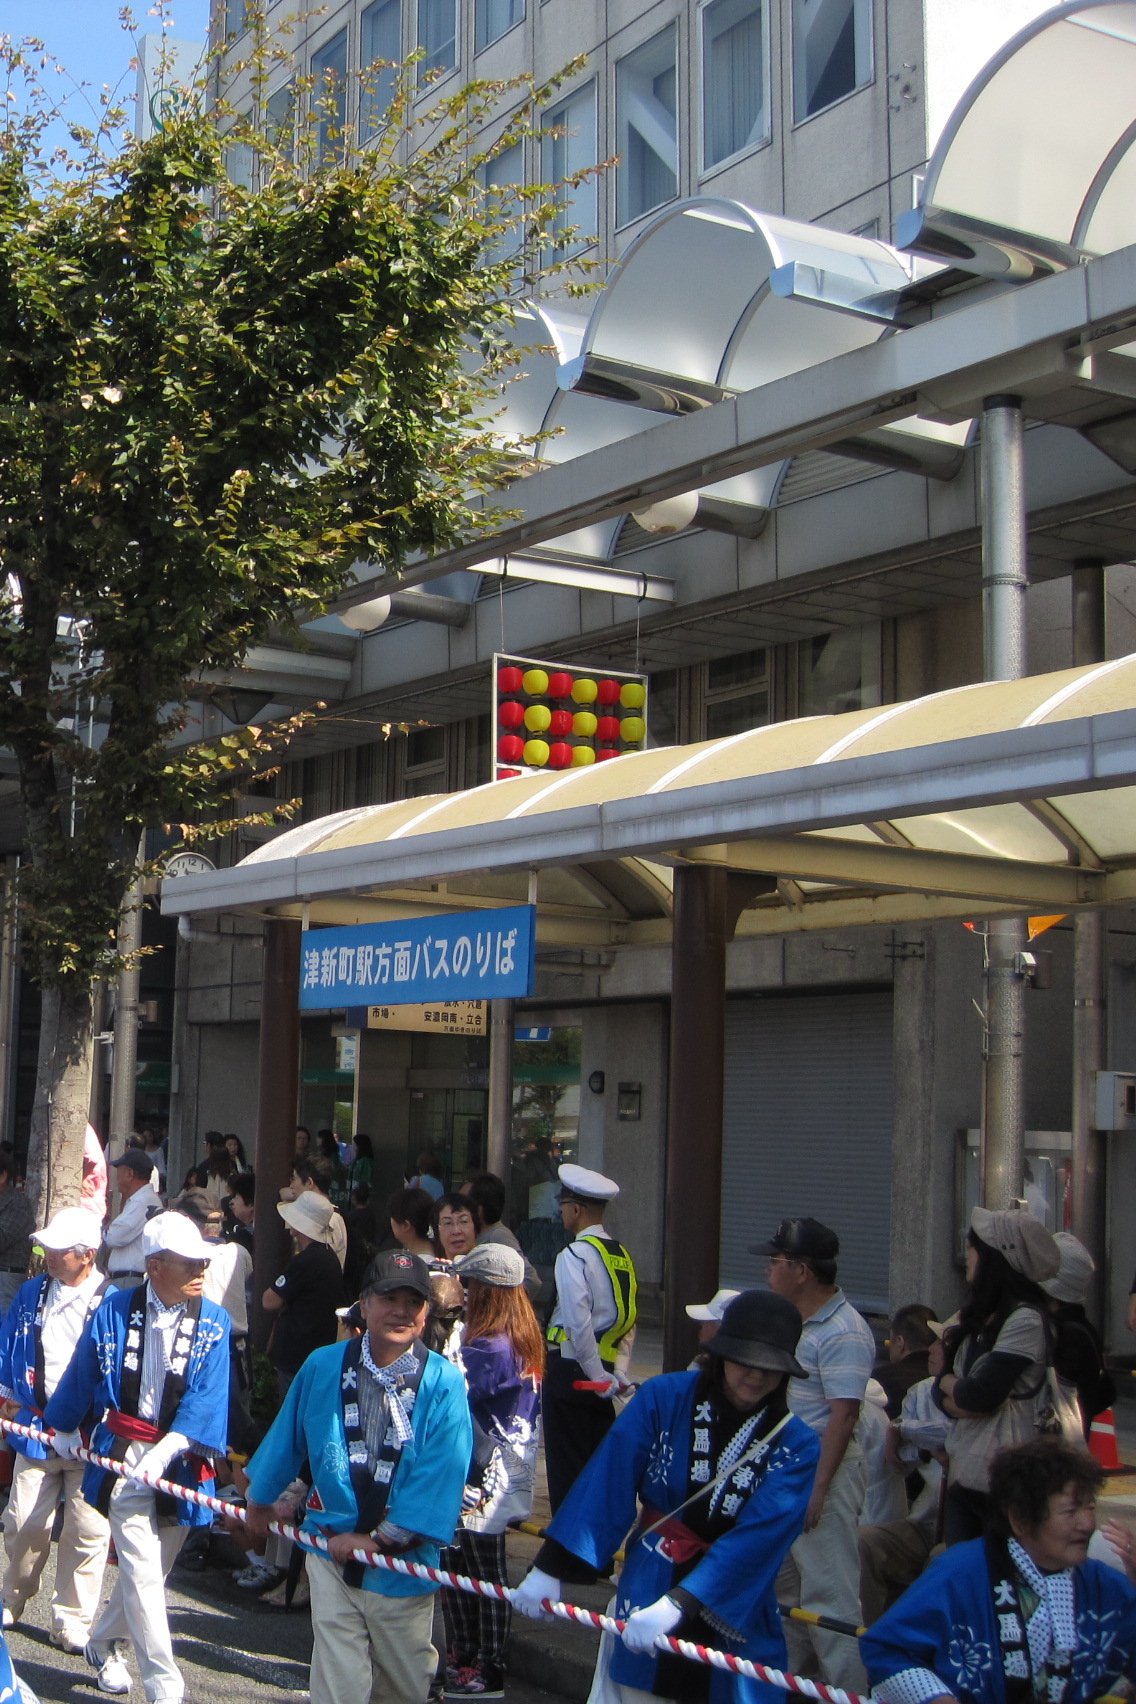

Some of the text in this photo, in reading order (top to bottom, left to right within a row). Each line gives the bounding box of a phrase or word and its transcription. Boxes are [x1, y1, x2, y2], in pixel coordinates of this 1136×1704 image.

[177, 861, 185, 869] 11
[188, 858, 197, 866] 12
[303, 928, 518, 989] 津新町駅方面バスのりば
